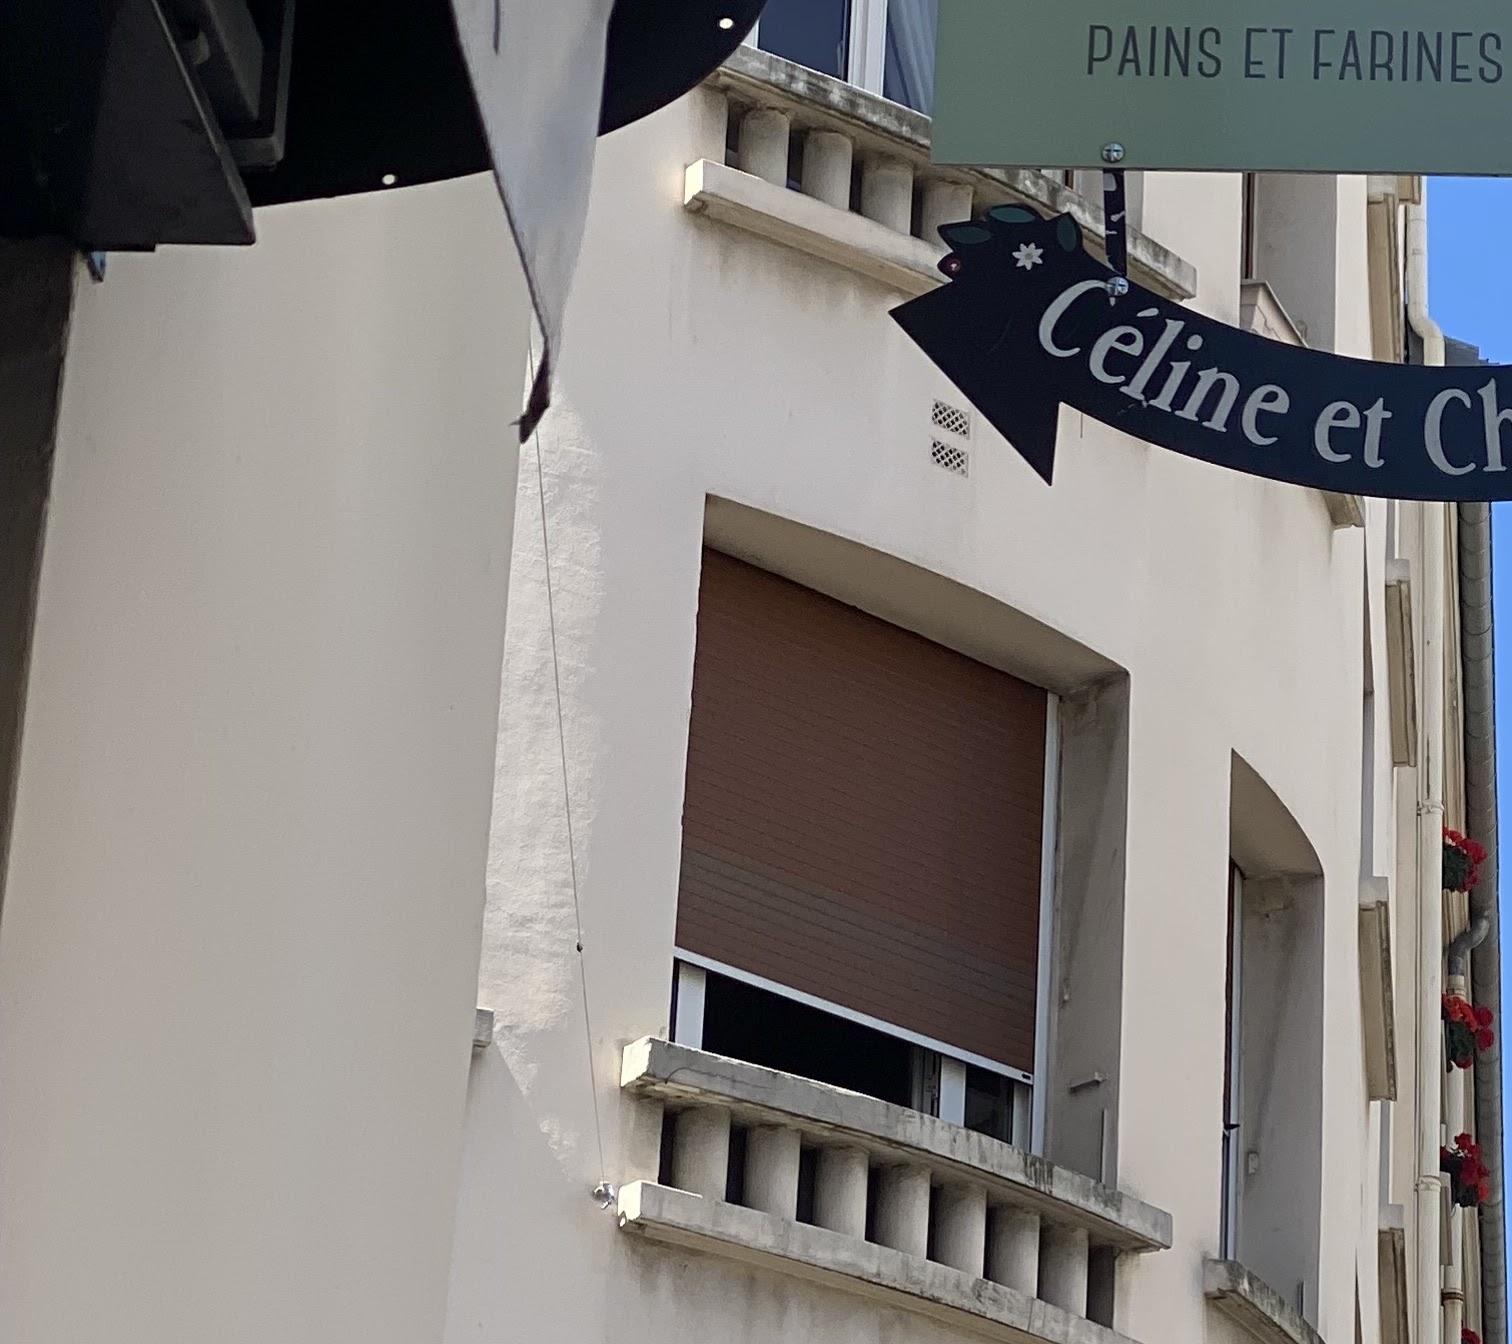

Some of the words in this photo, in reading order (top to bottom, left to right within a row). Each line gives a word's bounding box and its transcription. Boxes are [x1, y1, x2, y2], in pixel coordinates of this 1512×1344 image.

[1086, 24, 1222, 79] PAINS
[1244, 27, 1293, 80] ET
[1312, 29, 1503, 84] FARINES
[1038, 278, 1290, 447] Céline
[1314, 395, 1391, 469] et
